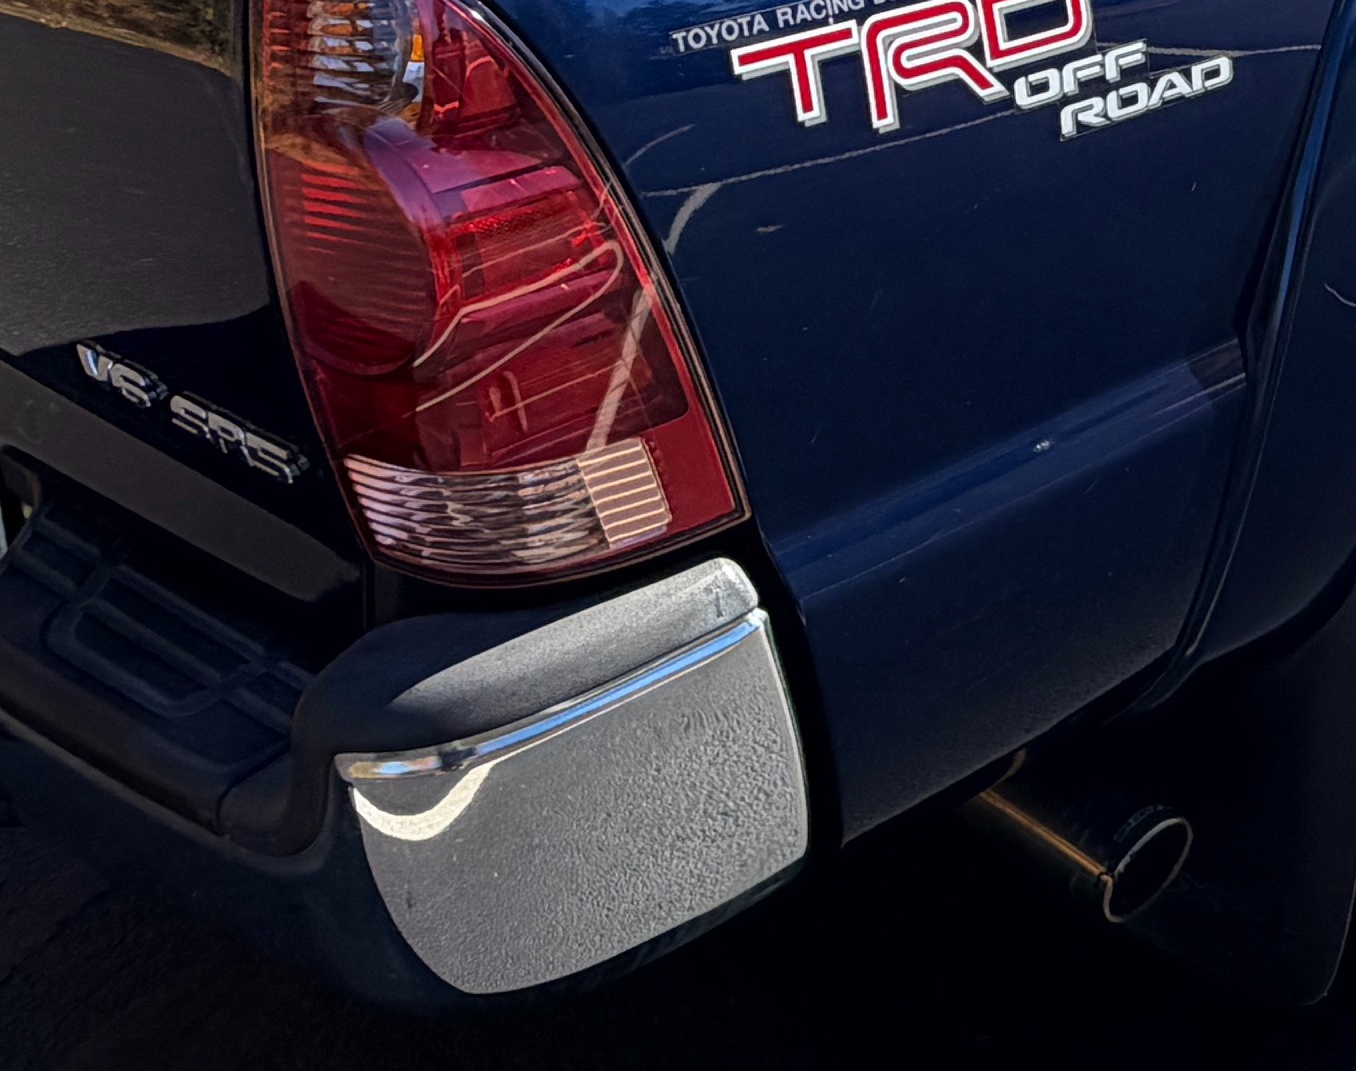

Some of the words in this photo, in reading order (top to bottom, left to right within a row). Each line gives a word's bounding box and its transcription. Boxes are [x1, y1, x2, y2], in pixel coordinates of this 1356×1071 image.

[672, 13, 769, 52] TOYOTA
[1014, 41, 1147, 110] OFF
[1060, 56, 1233, 137] ROAD
[76, 340, 160, 408] V6
